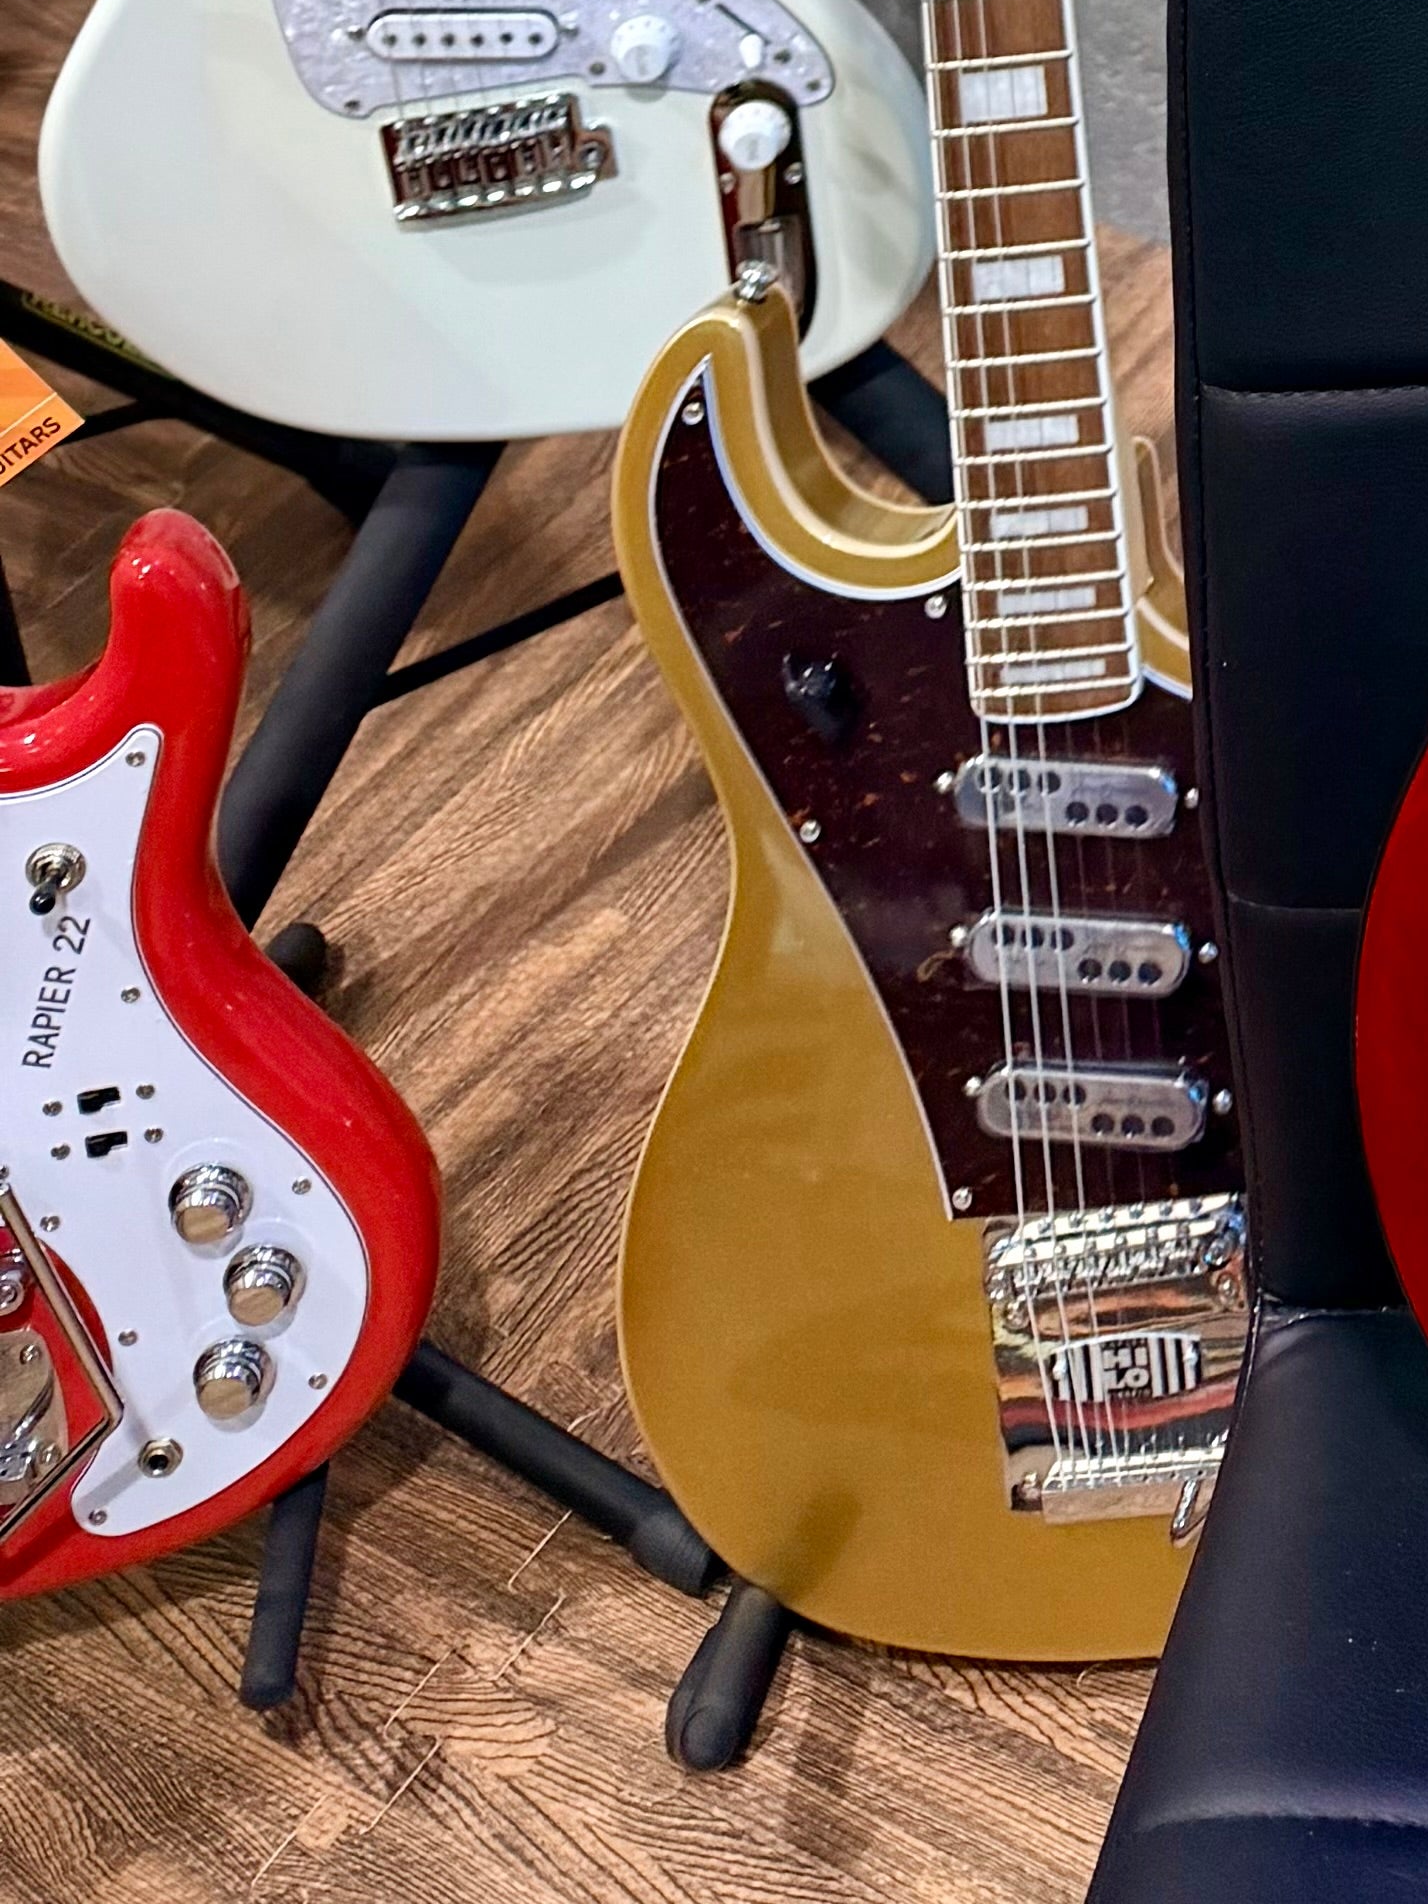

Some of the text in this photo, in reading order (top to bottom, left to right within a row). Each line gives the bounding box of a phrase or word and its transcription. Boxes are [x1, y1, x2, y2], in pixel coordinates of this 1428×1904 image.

[21, 915, 91, 1068] RAPIER 22
[1103, 1346, 1149, 1369] HI
[1101, 1367, 1150, 1390] LO
